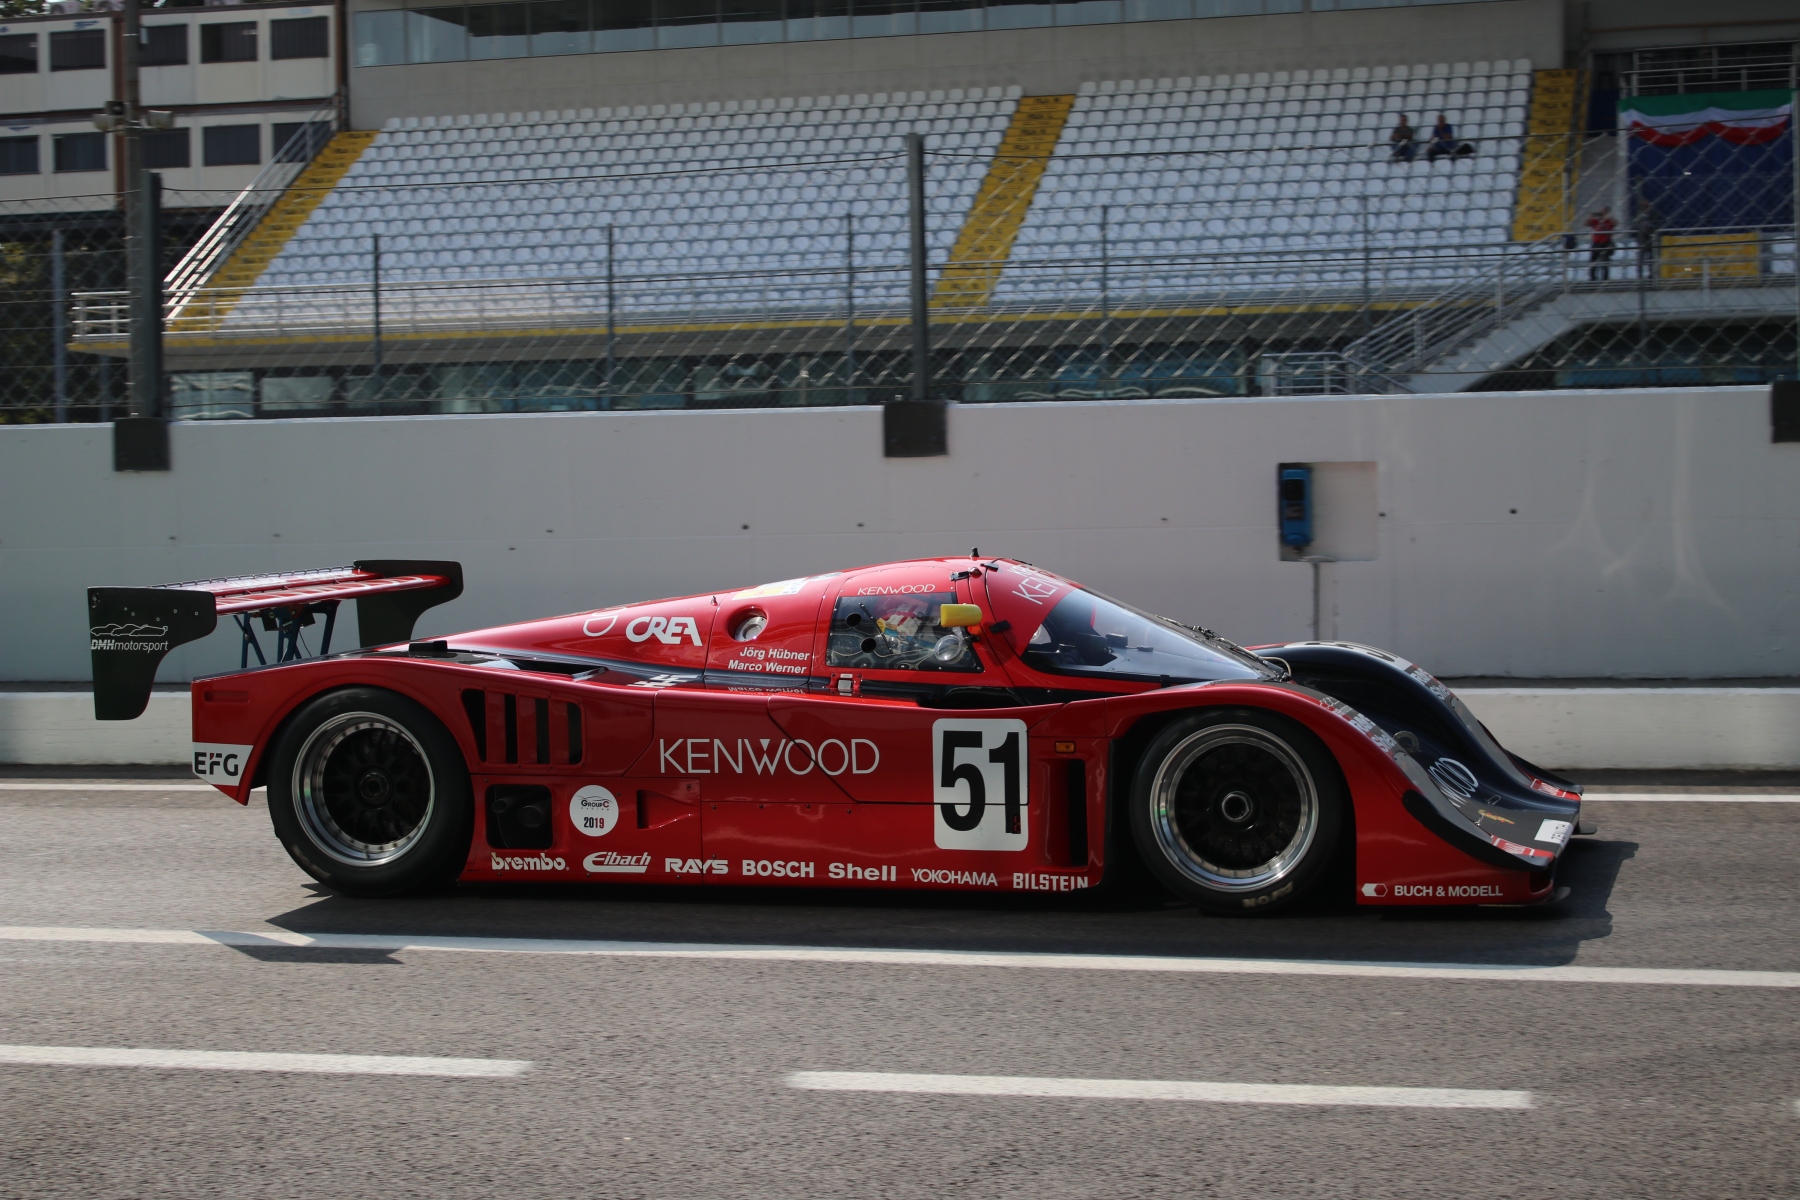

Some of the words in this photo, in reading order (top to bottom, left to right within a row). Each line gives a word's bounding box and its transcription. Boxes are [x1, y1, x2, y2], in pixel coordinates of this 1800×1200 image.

[858, 584, 936, 595] KENWOOD
[626, 617, 703, 646] CREA
[91, 640, 169, 653] DMHmotorsport
[740, 647, 766, 659] Jörg
[768, 648, 809, 661] Hübner
[728, 659, 762, 671] Marco
[766, 662, 807, 674] Werner
[194, 752, 239, 777] EFG
[659, 738, 880, 776] KENWOOD
[940, 730, 1021, 834] 51
[583, 816, 605, 829] 2019
[583, 852, 652, 873] Eibach
[665, 858, 729, 875] RAYS
[742, 860, 815, 878] BOSCH
[828, 863, 897, 882] Shell
[911, 867, 999, 887] YOKOHAMA
[1013, 873, 1089, 891] BILSTEIN
[1394, 885, 1433, 897] BUCH
[1435, 885, 1445, 897] &
[1448, 885, 1504, 897] MODELL
